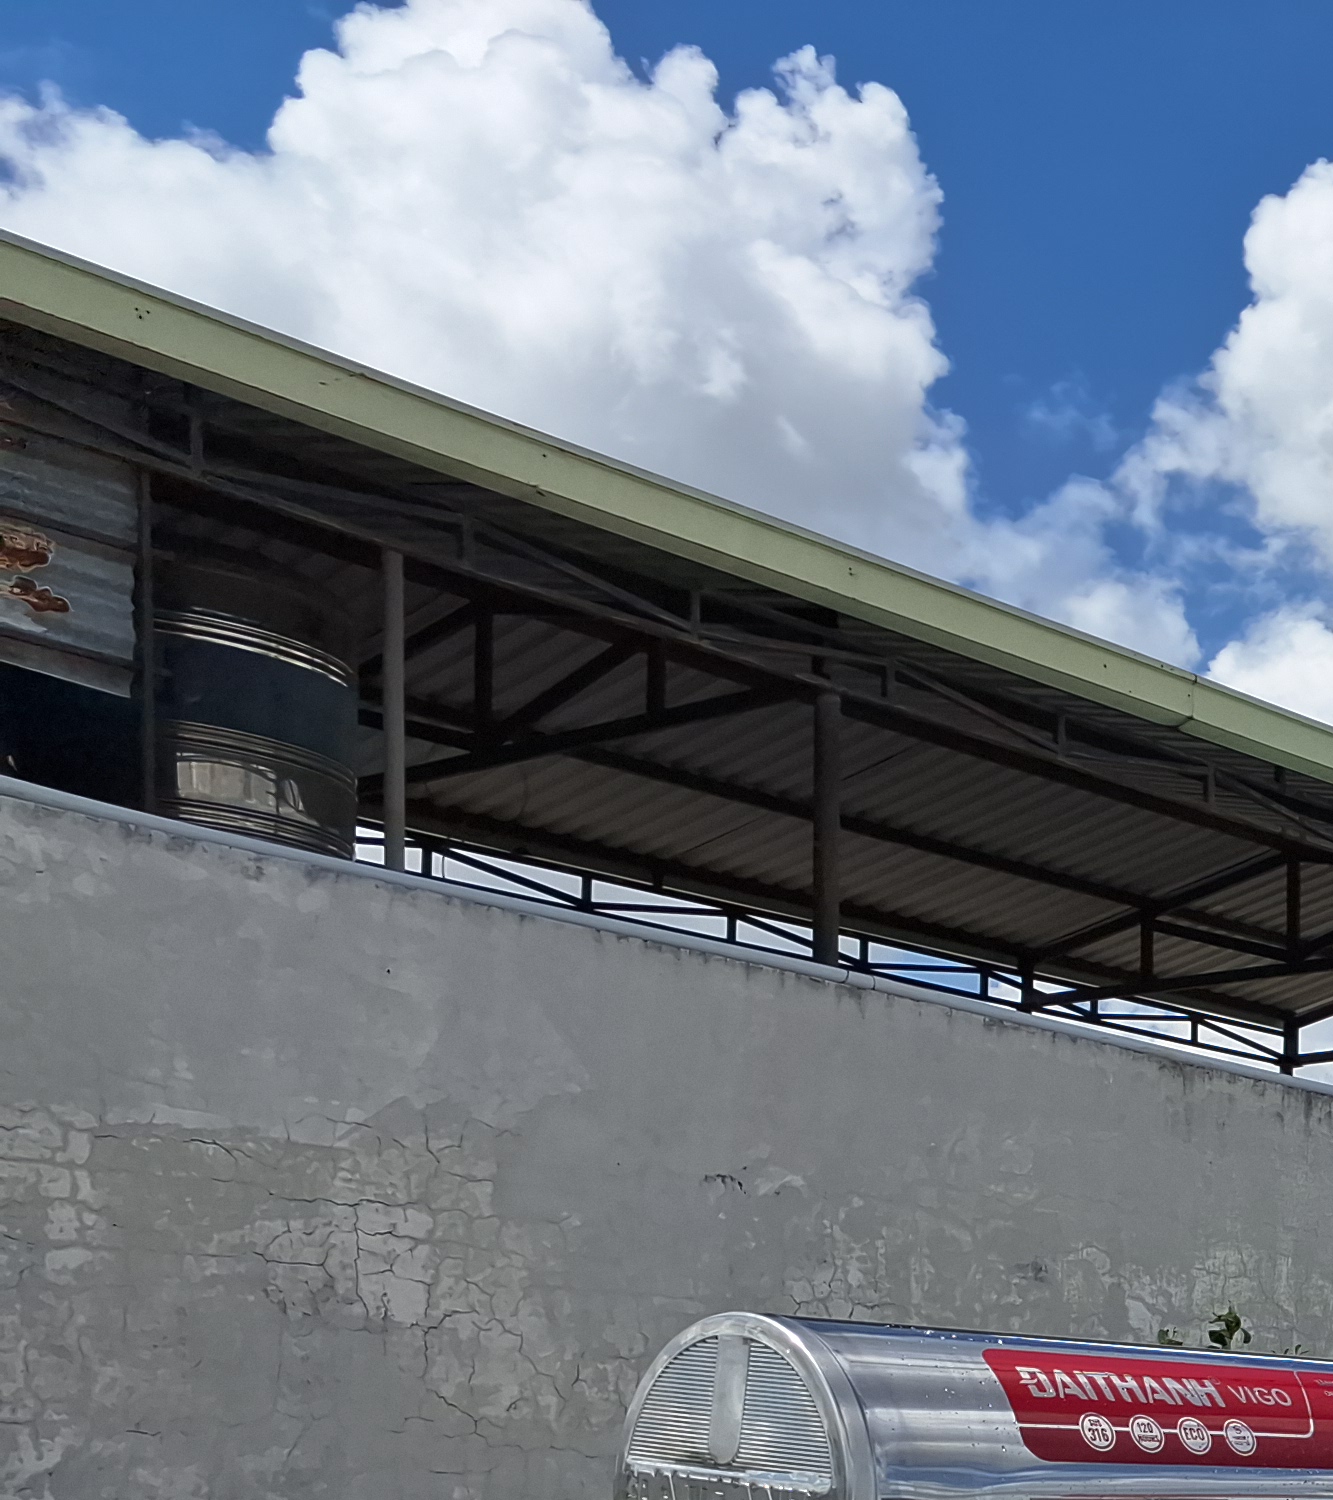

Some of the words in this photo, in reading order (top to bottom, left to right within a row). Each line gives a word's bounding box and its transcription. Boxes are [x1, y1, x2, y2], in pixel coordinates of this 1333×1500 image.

[1227, 1385, 1293, 1406] VIGO
[1137, 1422, 1153, 1433] 120
[1183, 1427, 1206, 1441] ECO
[1088, 1428, 1110, 1442] 316
